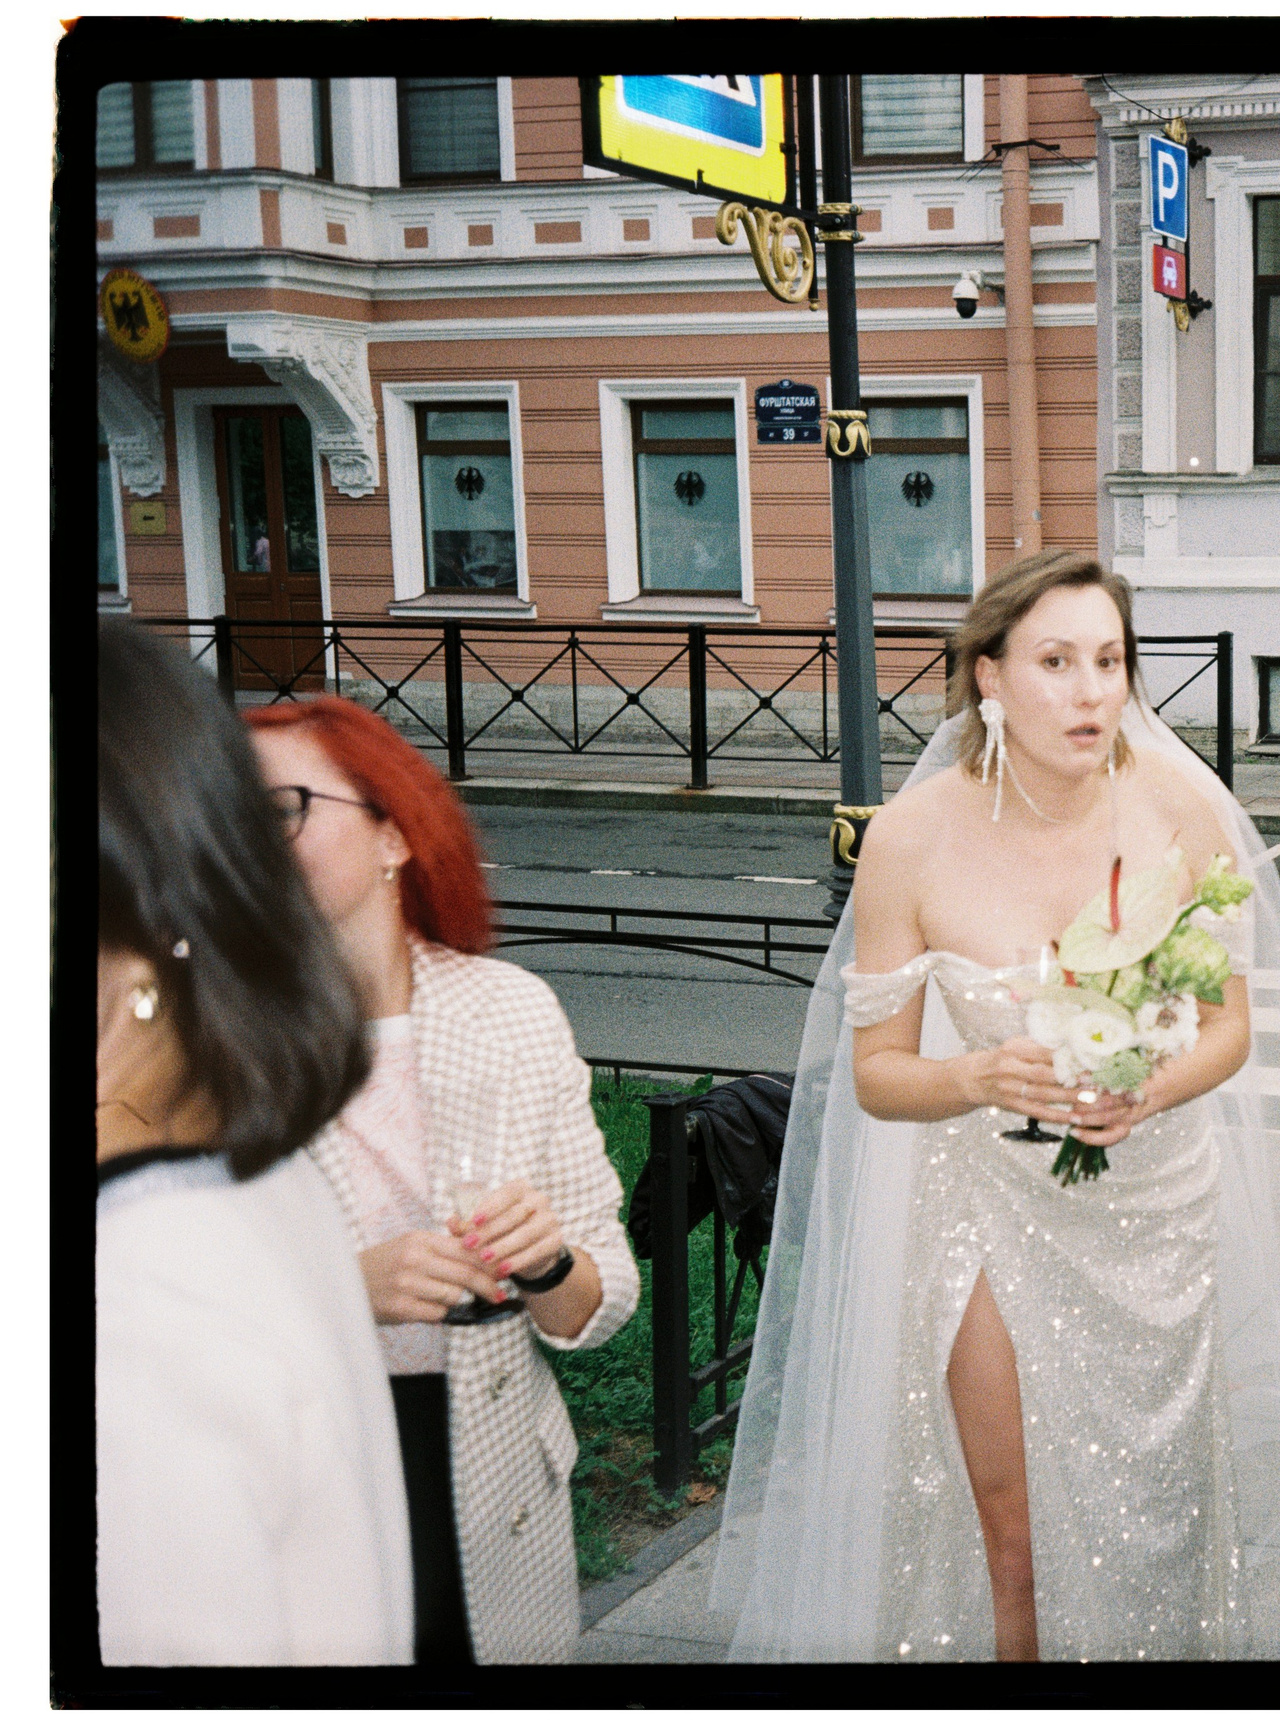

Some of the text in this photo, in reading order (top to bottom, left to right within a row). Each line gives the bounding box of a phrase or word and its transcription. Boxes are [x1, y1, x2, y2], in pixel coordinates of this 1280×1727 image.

[1158, 150, 1179, 222] P
[759, 396, 816, 407] ФУРШТАТСКАЯ
[783, 428, 795, 440] 39
